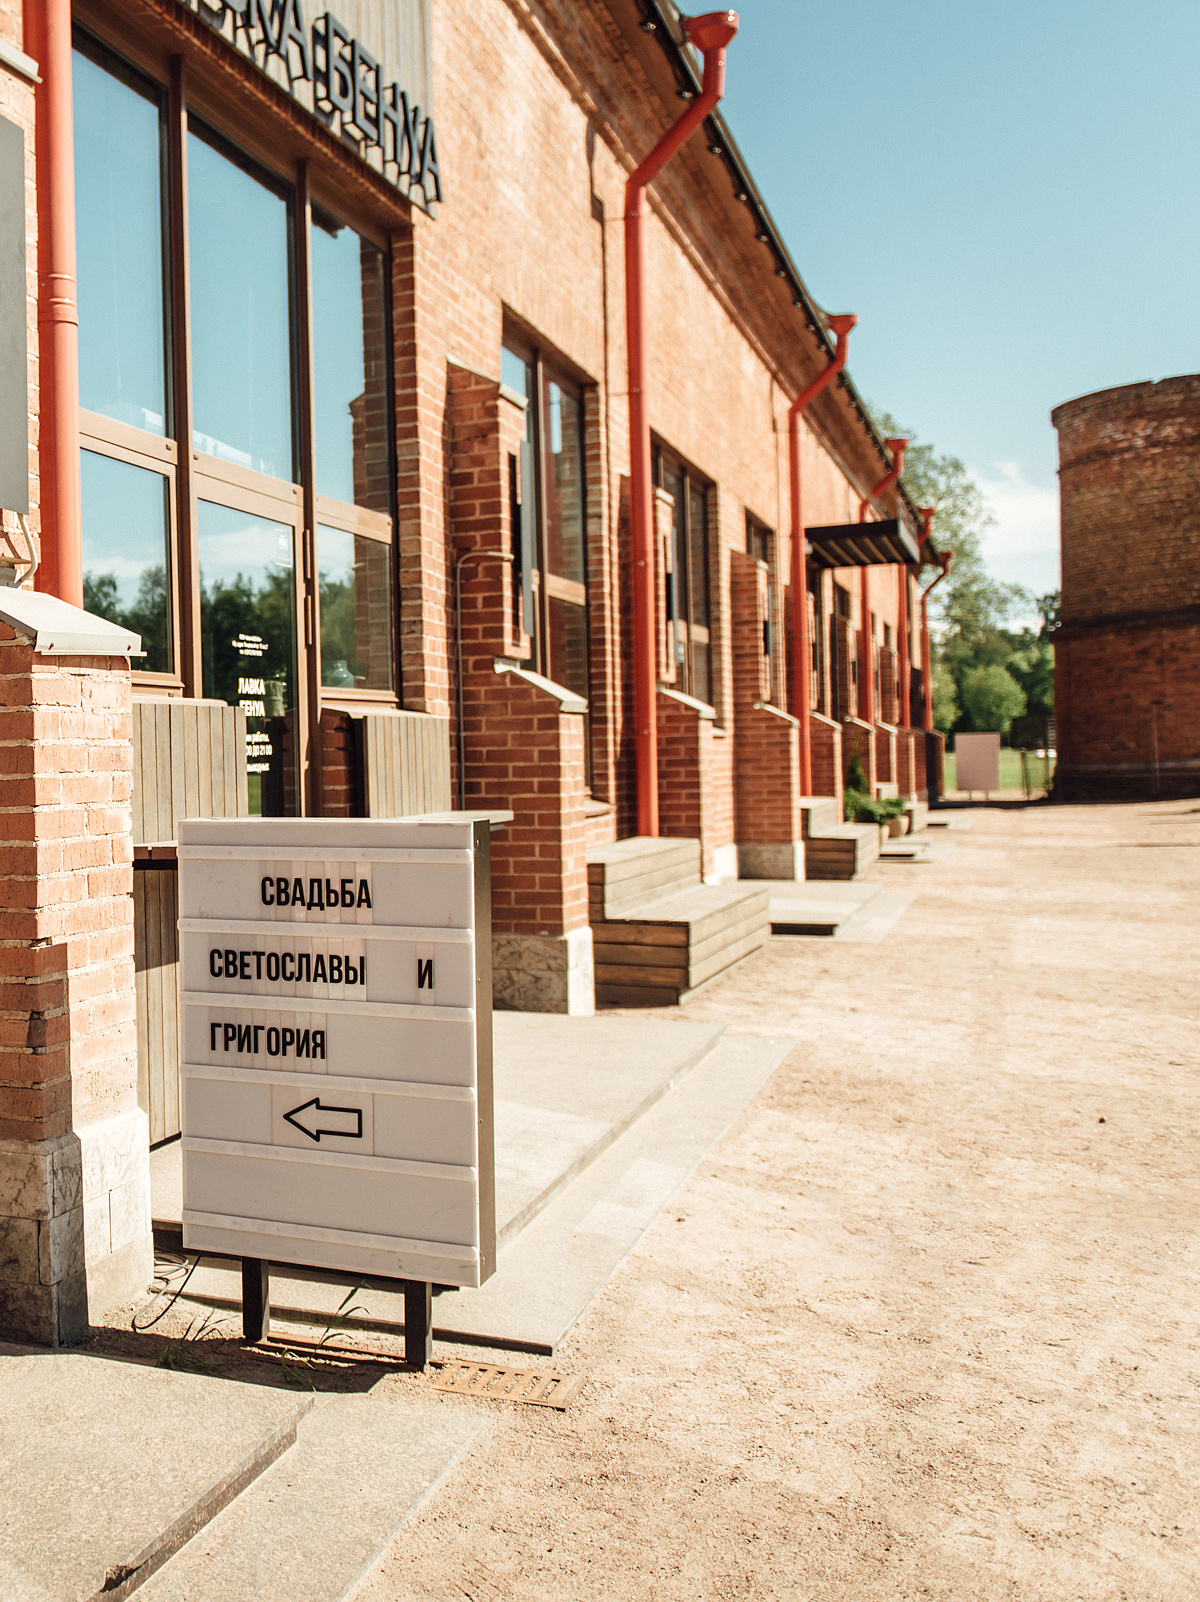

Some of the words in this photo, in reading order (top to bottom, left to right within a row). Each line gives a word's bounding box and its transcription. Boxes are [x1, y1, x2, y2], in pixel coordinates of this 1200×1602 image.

[325, 12, 442, 204] БЕНУА
[237, 677, 266, 695] ЛАВКА
[261, 877, 372, 911] СВАДЬБА
[210, 949, 365, 986] СВЕТОСЛАВЫ
[417, 959, 433, 989] И
[211, 1023, 326, 1059] ГРИГОРИЯ
